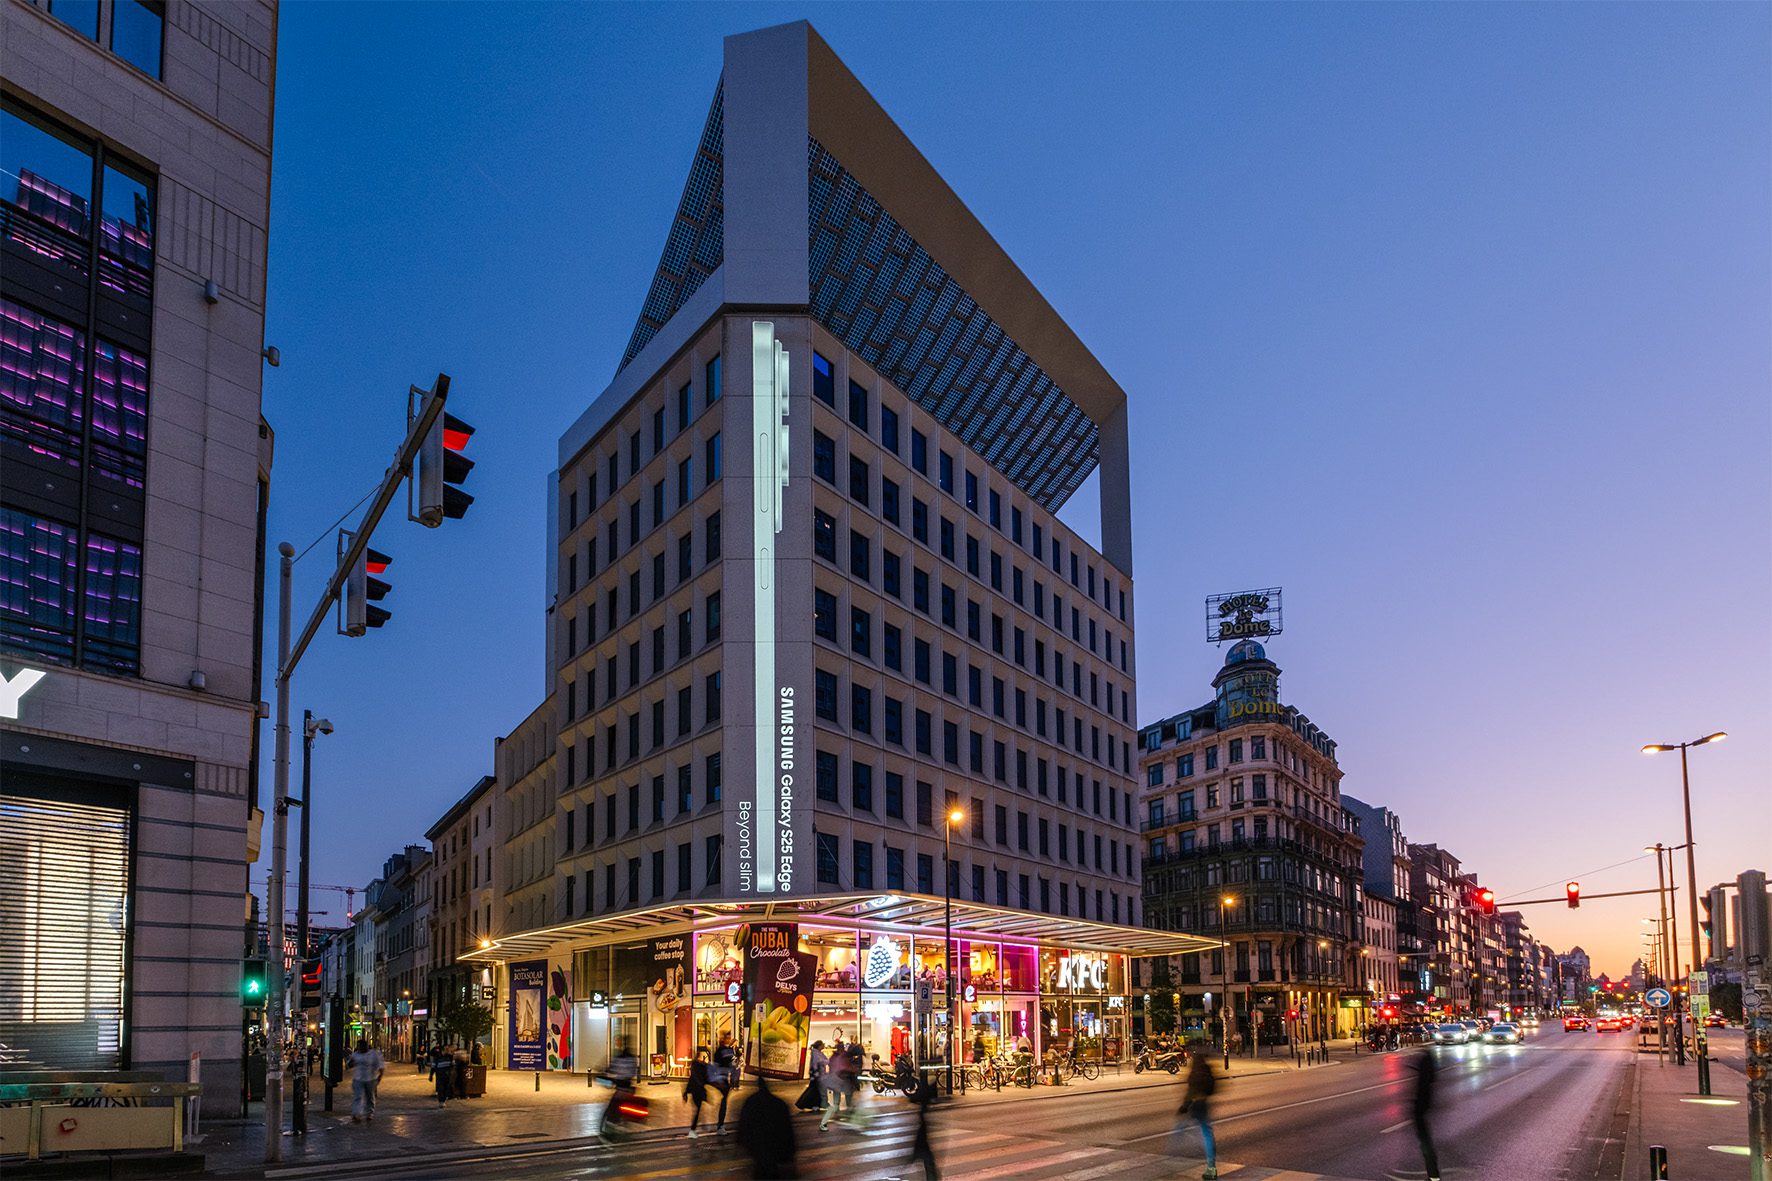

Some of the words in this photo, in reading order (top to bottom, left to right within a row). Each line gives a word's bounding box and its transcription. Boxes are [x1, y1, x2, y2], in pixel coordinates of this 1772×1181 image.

[1219, 594, 1269, 616] HOTEL
[1238, 610, 1253, 619] Le
[780, 686, 794, 770] SAMSUNG
[778, 774, 794, 828] Galaxy
[736, 801, 751, 859] Beyond
[780, 830, 793, 853] S25
[740, 862, 752, 892] slim
[777, 856, 793, 892] Edge
[655, 941, 668, 950] Your
[668, 938, 684, 950] daily
[752, 932, 789, 948] DUBAI
[654, 952, 671, 960] coffee
[671, 950, 684, 960] stop
[750, 946, 790, 959] Chocolate
[1056, 957, 1107, 989] KFC
[775, 981, 797, 991] DELYS
[1108, 996, 1124, 1008] KFC
